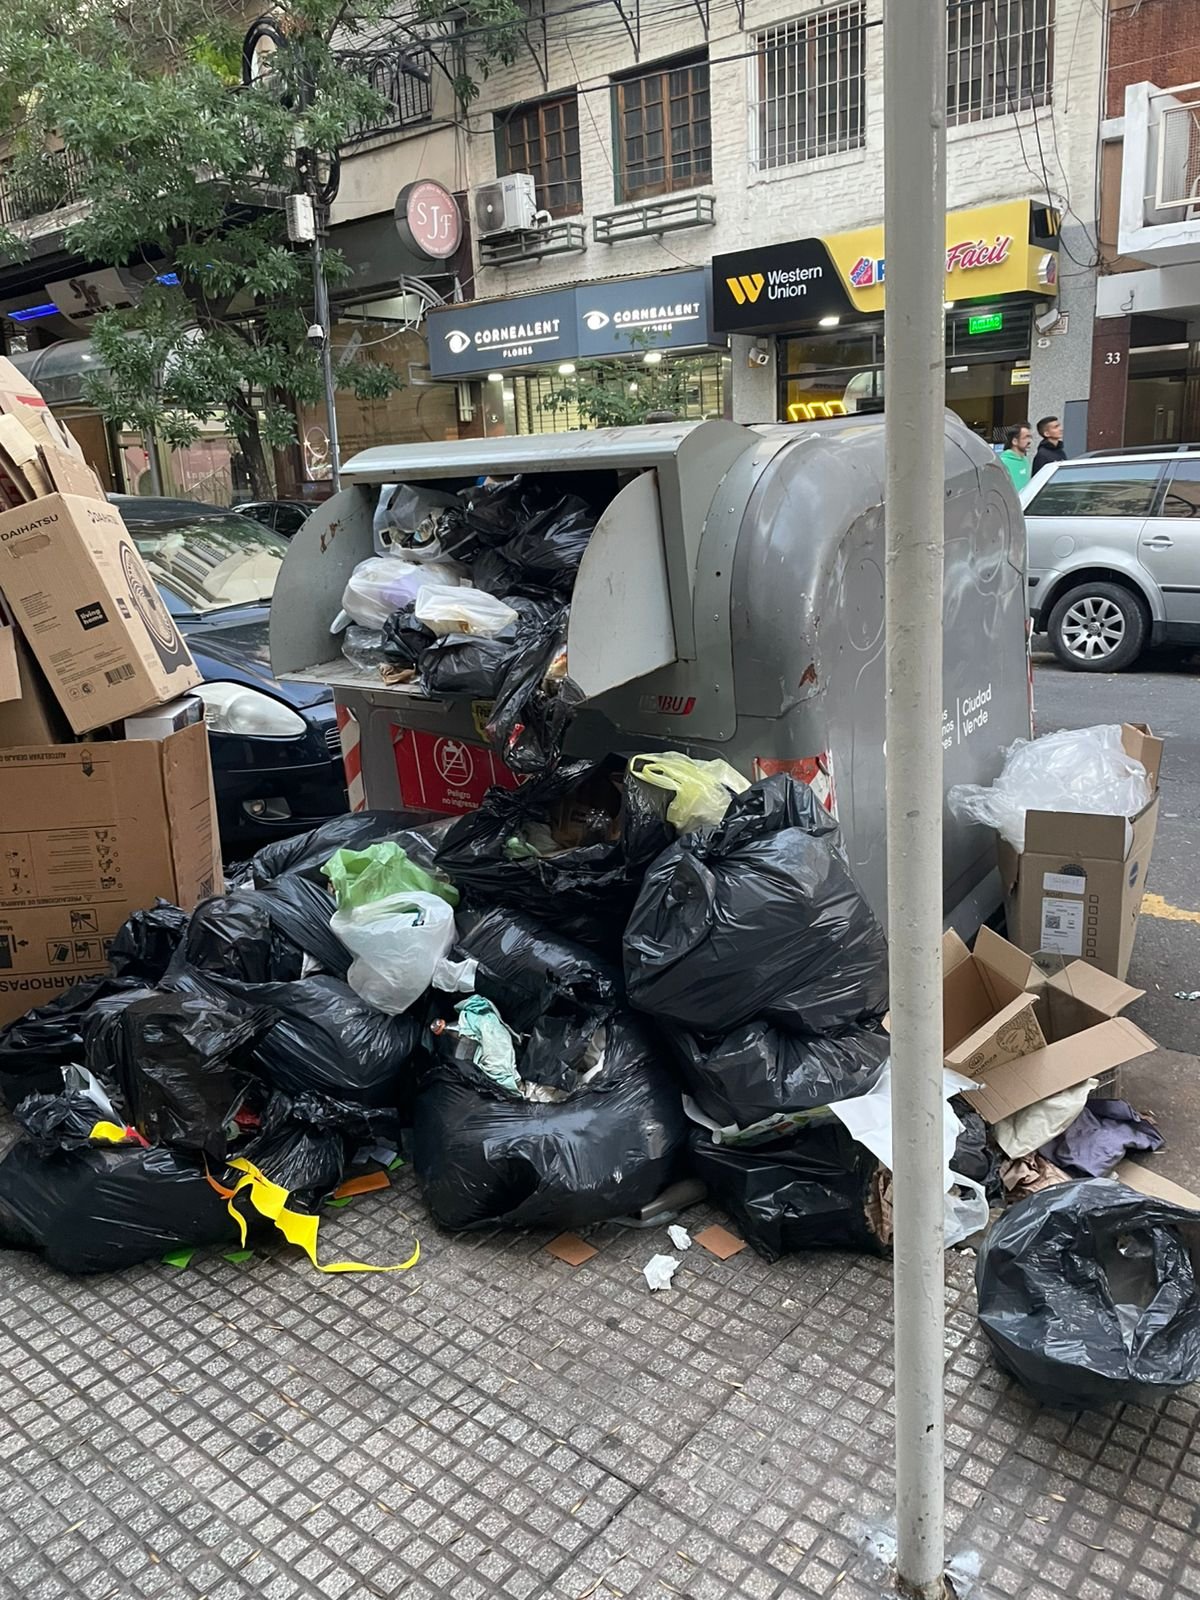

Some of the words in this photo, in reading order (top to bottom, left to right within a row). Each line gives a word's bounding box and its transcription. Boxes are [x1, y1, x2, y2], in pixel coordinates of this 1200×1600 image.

[946, 236, 1011, 271] Fácil
[767, 266, 823, 285] Western
[767, 284, 807, 300] Union
[613, 303, 700, 323] CORNEALENT
[474, 319, 560, 344] CORNEALENT
[502, 346, 533, 358] FLORES
[1104, 352, 1121, 365] 33
[0, 514, 59, 542] DAIHATSU
[80, 608, 101, 620] living
[83, 615, 103, 626] home
[963, 683, 992, 716] Ciudad
[963, 708, 989, 737] Verde
[447, 788, 471, 799] Peligro
